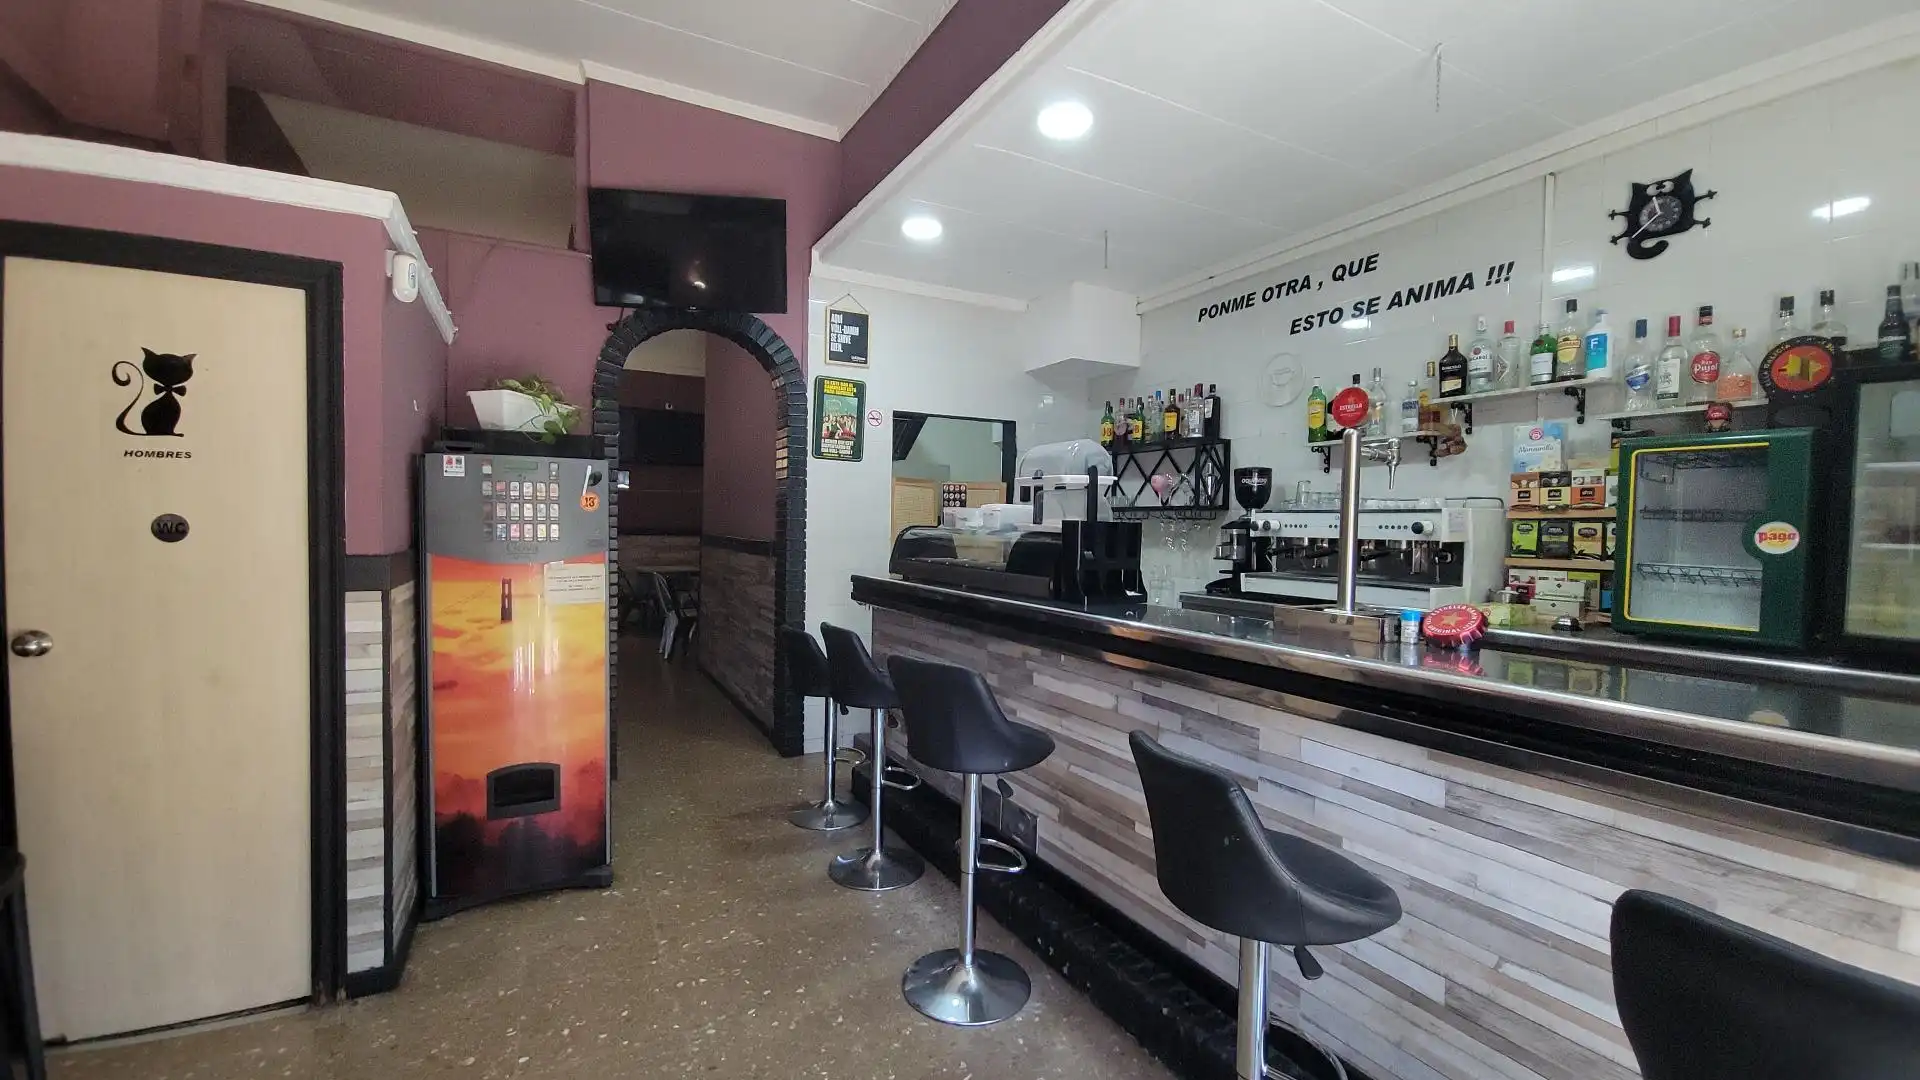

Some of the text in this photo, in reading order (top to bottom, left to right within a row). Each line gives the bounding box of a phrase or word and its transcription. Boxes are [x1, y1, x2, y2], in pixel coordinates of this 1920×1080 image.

[1198, 291, 1256, 323] PONME
[1261, 274, 1312, 304] OTRA
[1331, 252, 1380, 283] QUE
[1289, 260, 1516, 336] ESTO SE ANIMA !!!
[123, 449, 192, 459] HOMBRES
[156, 522, 187, 534] WC
[1757, 531, 1796, 543] pago
